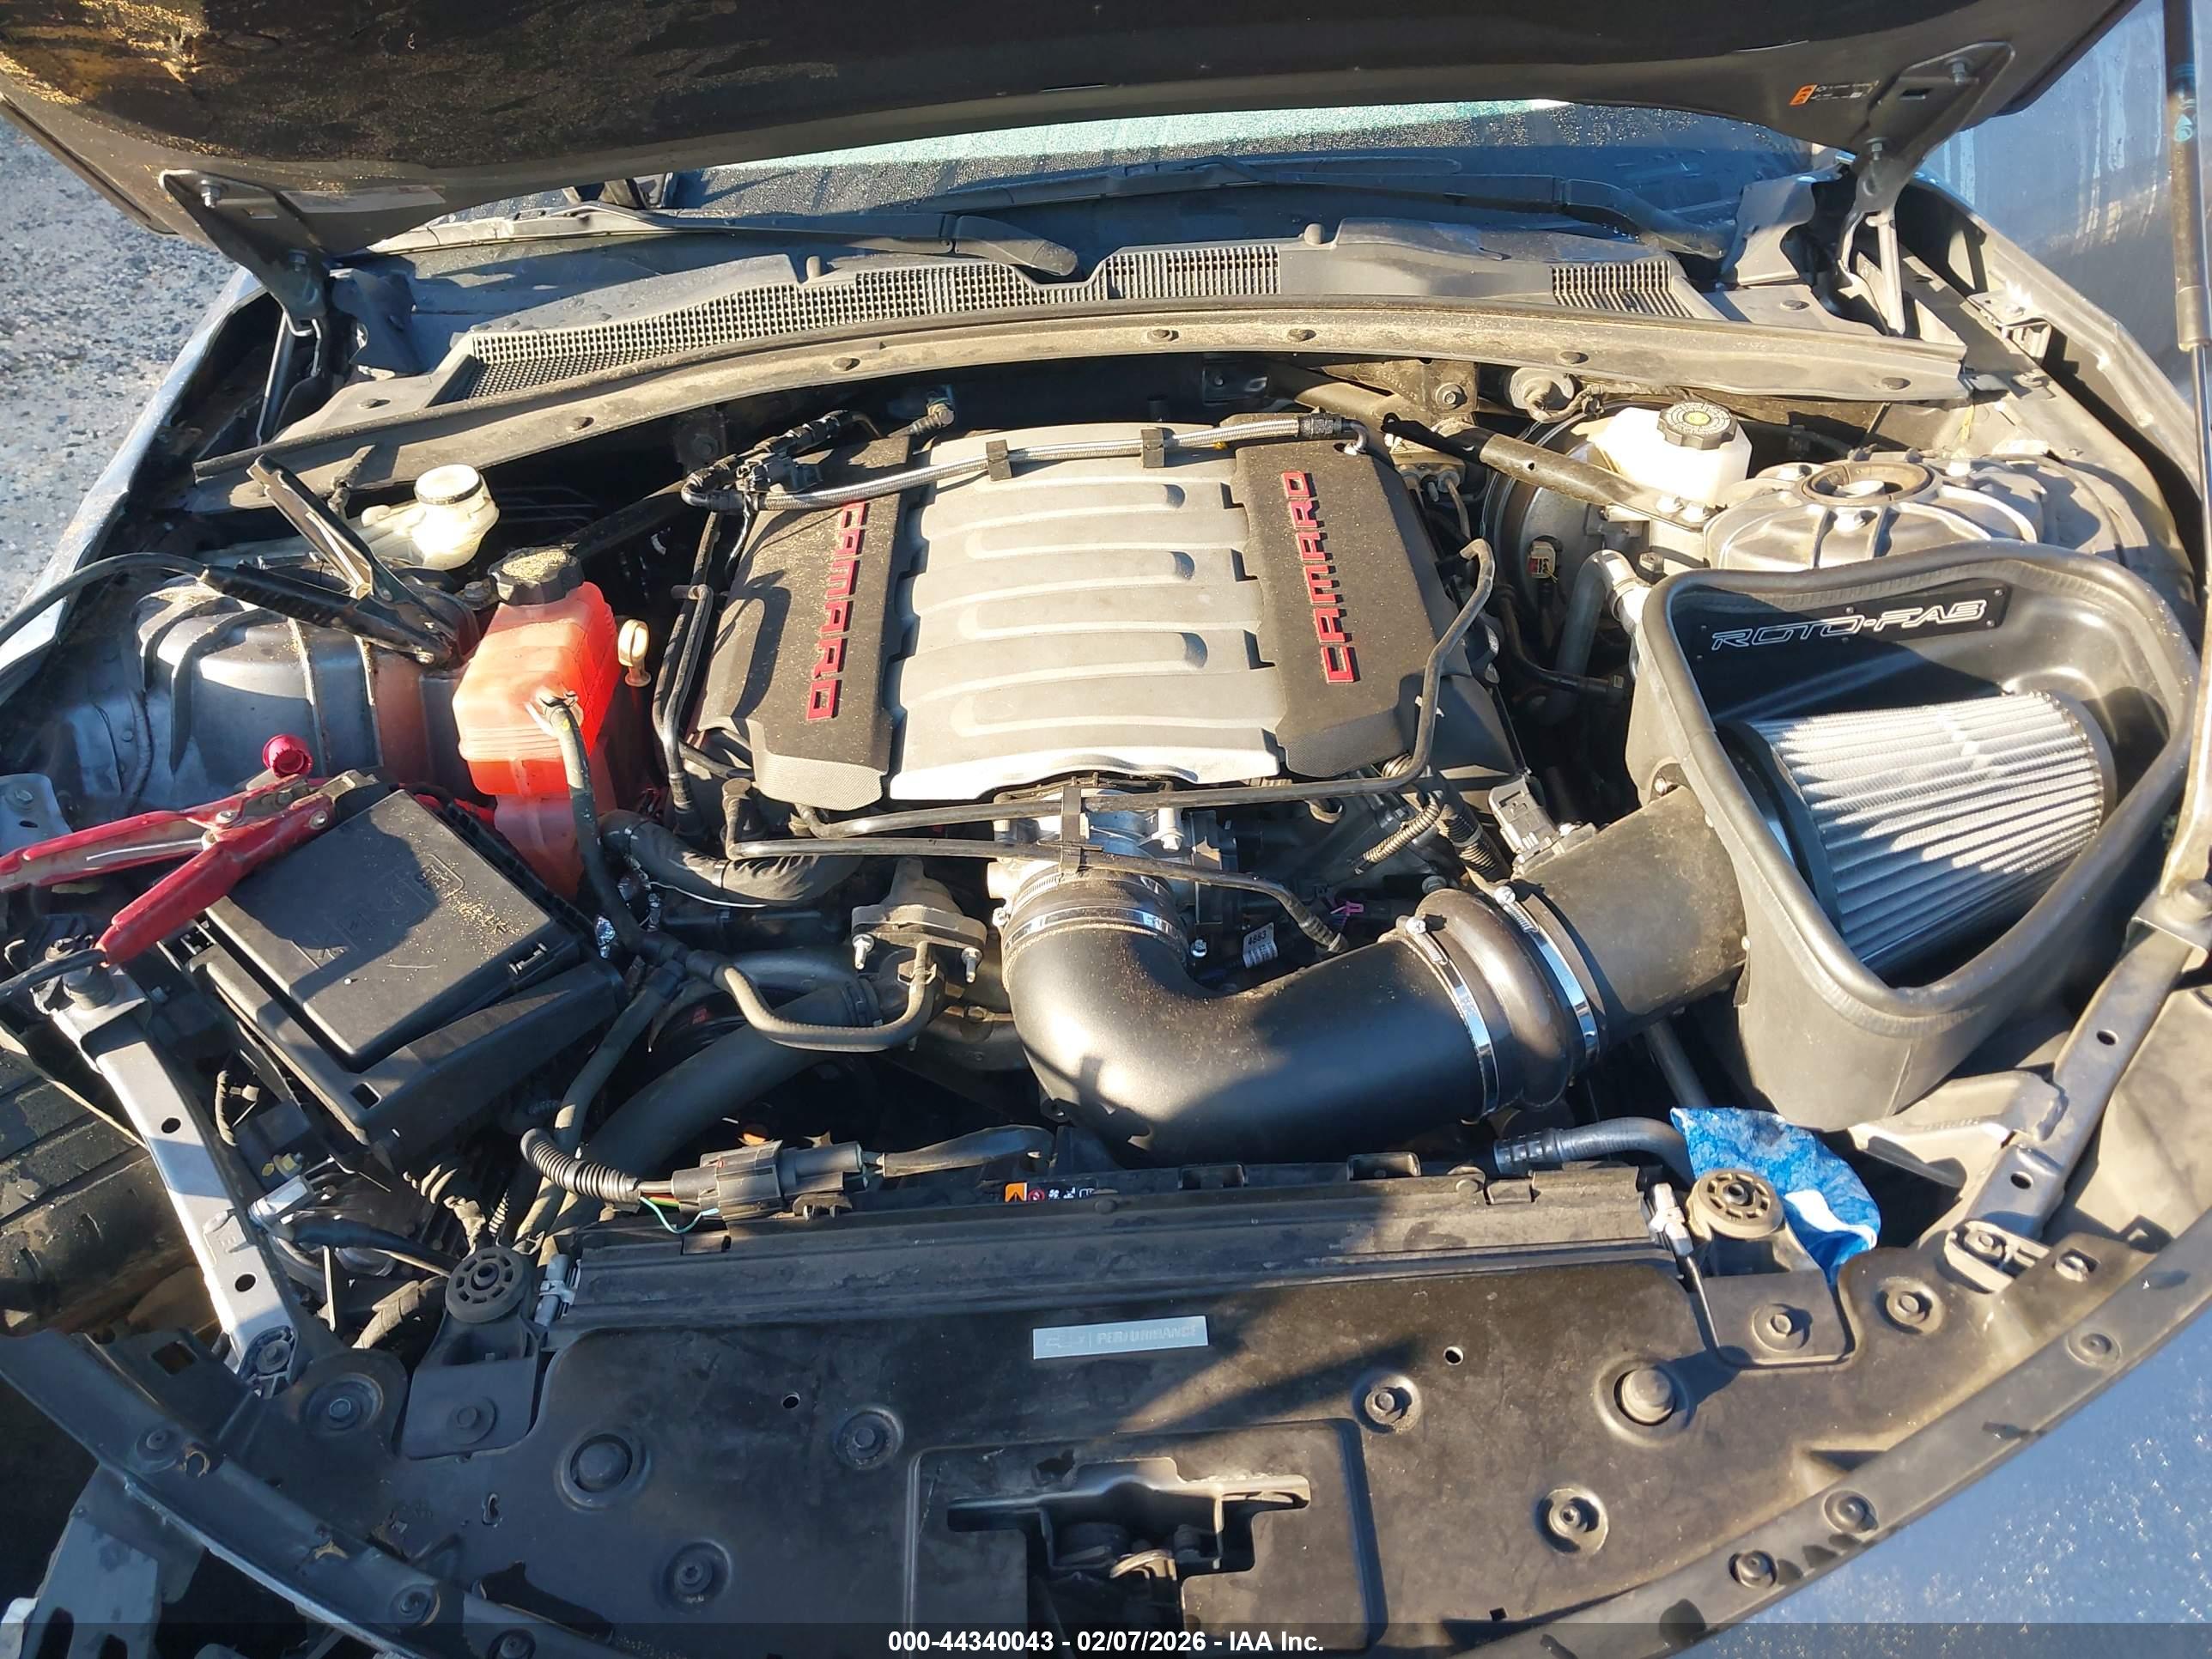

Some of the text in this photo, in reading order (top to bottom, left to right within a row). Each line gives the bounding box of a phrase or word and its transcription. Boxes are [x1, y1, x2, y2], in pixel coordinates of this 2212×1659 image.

[807, 501, 866, 720] CAMARO
[1281, 471, 1354, 683] CAMARO
[1711, 599, 1987, 651] ROTO-FAB
